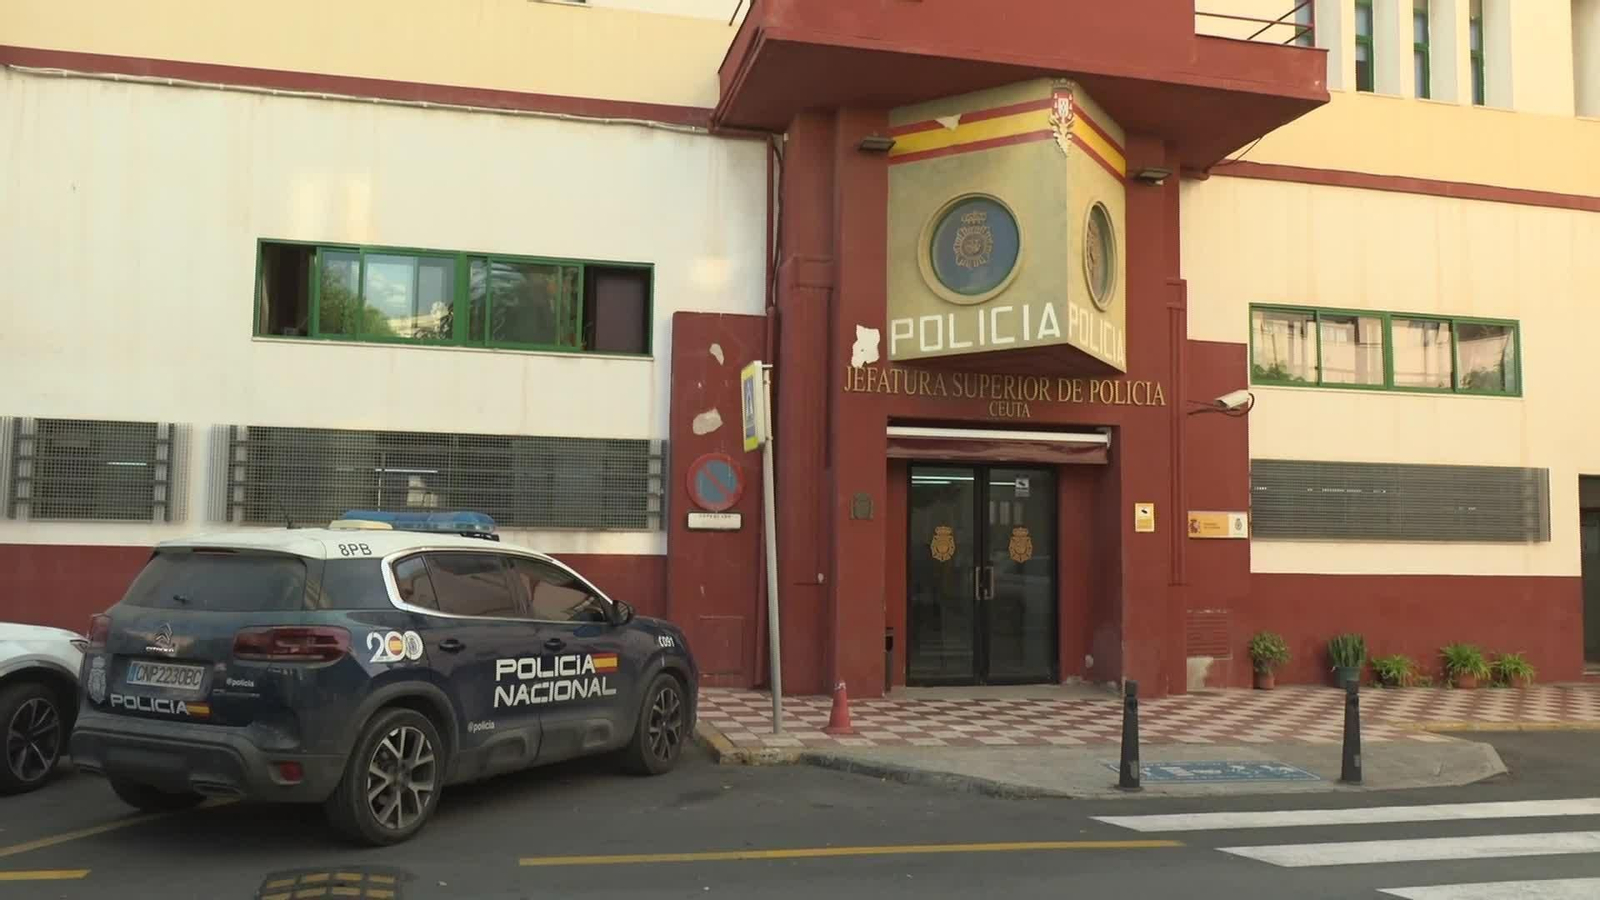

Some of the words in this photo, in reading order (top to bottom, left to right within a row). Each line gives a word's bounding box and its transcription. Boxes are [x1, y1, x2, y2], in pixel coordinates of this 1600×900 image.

[891, 302, 1061, 355] POLICIA
[1068, 302, 1126, 366] POLICIA
[844, 365, 948, 398] JEFATURA
[952, 371, 1051, 402] SUPERIOR
[1058, 376, 1083, 403] DE
[1090, 379, 1166, 406] POLICIA
[988, 401, 1031, 418] CEUTA
[338, 543, 372, 557] 8PB
[493, 677, 617, 708] NACIONAL
